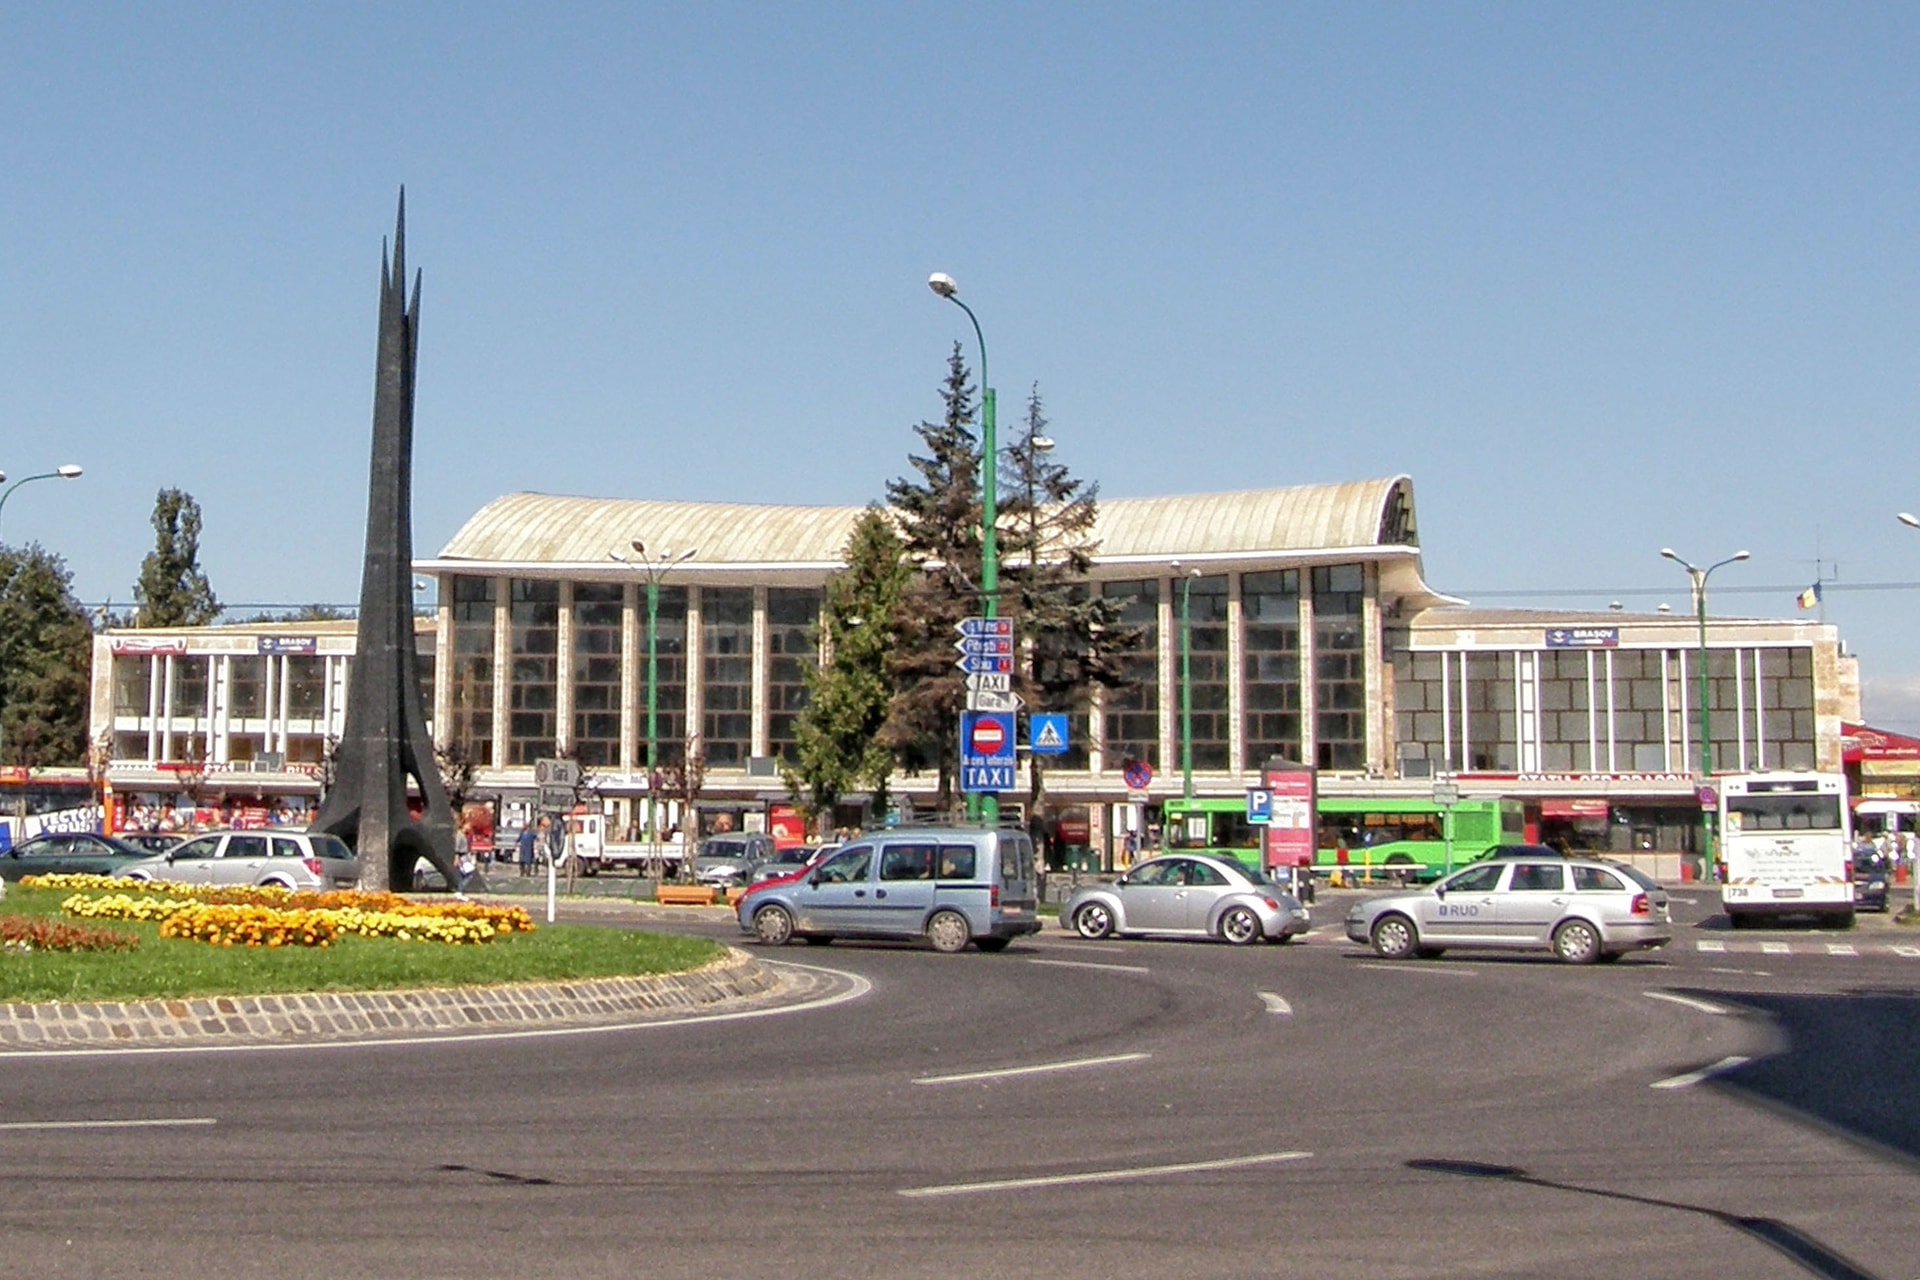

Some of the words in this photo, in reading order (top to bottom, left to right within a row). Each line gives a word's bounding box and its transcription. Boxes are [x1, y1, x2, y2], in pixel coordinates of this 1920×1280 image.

[967, 768, 1010, 785] TAXI
[1252, 791, 1268, 811] P
[1450, 905, 1479, 916] RUD
